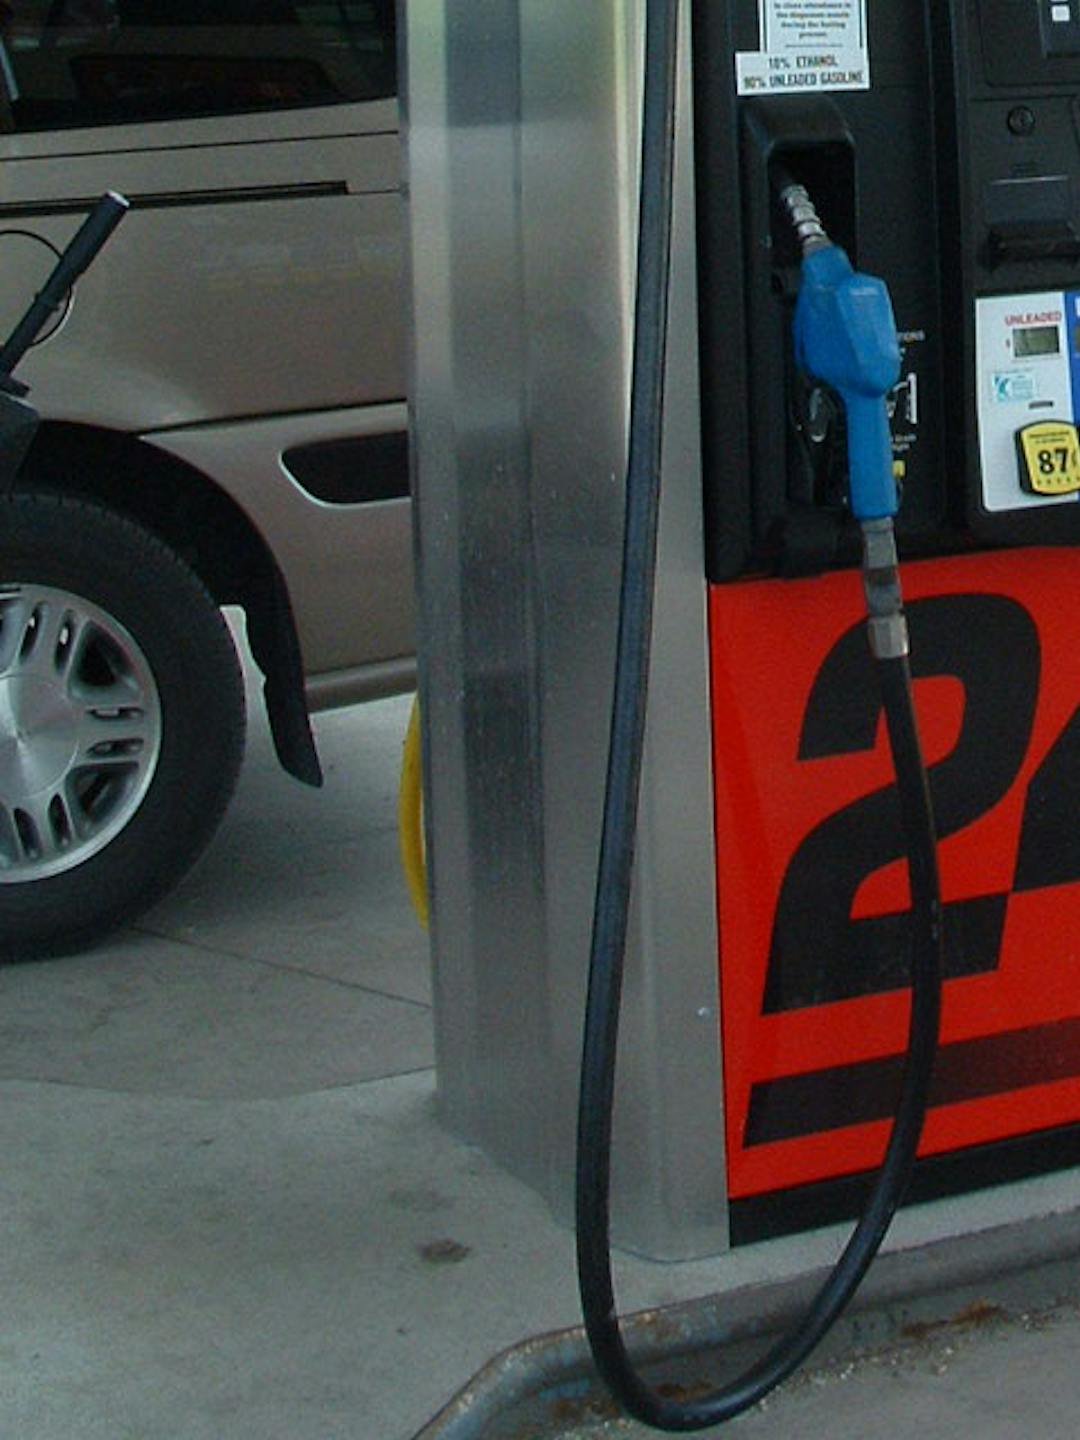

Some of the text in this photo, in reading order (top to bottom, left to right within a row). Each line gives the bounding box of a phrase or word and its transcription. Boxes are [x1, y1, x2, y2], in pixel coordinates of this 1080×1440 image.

[796, 54, 838, 68] ETHANOL
[769, 73, 817, 88] UNLEADED
[821, 70, 864, 85] GASOLINE
[1004, 311, 1062, 327] UNLEADED
[1037, 448, 1069, 475] 87
